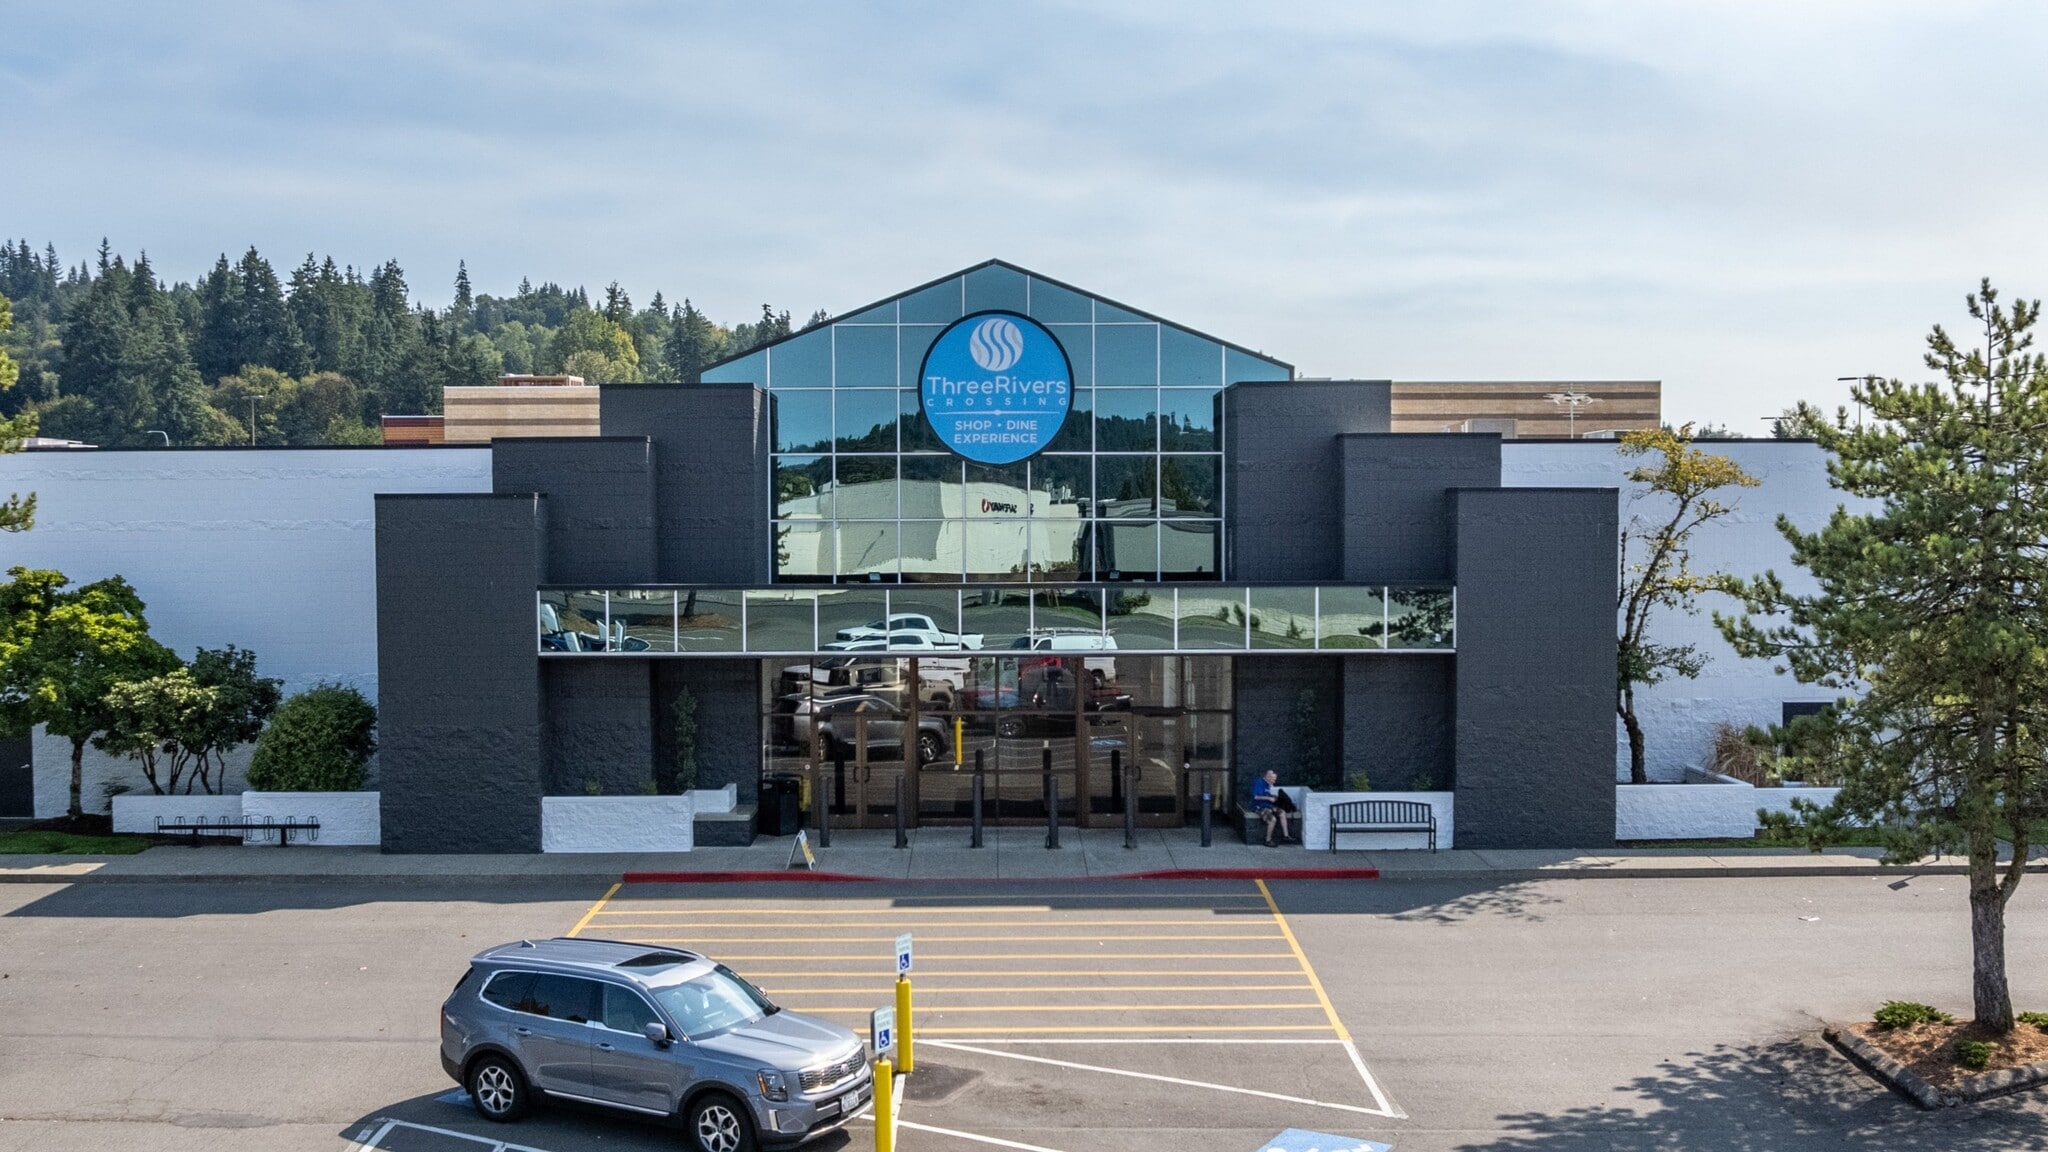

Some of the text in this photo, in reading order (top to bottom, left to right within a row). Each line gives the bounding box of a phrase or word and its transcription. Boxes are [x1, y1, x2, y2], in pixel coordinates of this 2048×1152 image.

[927, 376, 1066, 395] ThreeRivers
[927, 398, 1066, 407] CROSSING
[955, 420, 1038, 431] SHOP DINE
[954, 433, 1038, 444] EXPERIENCE
